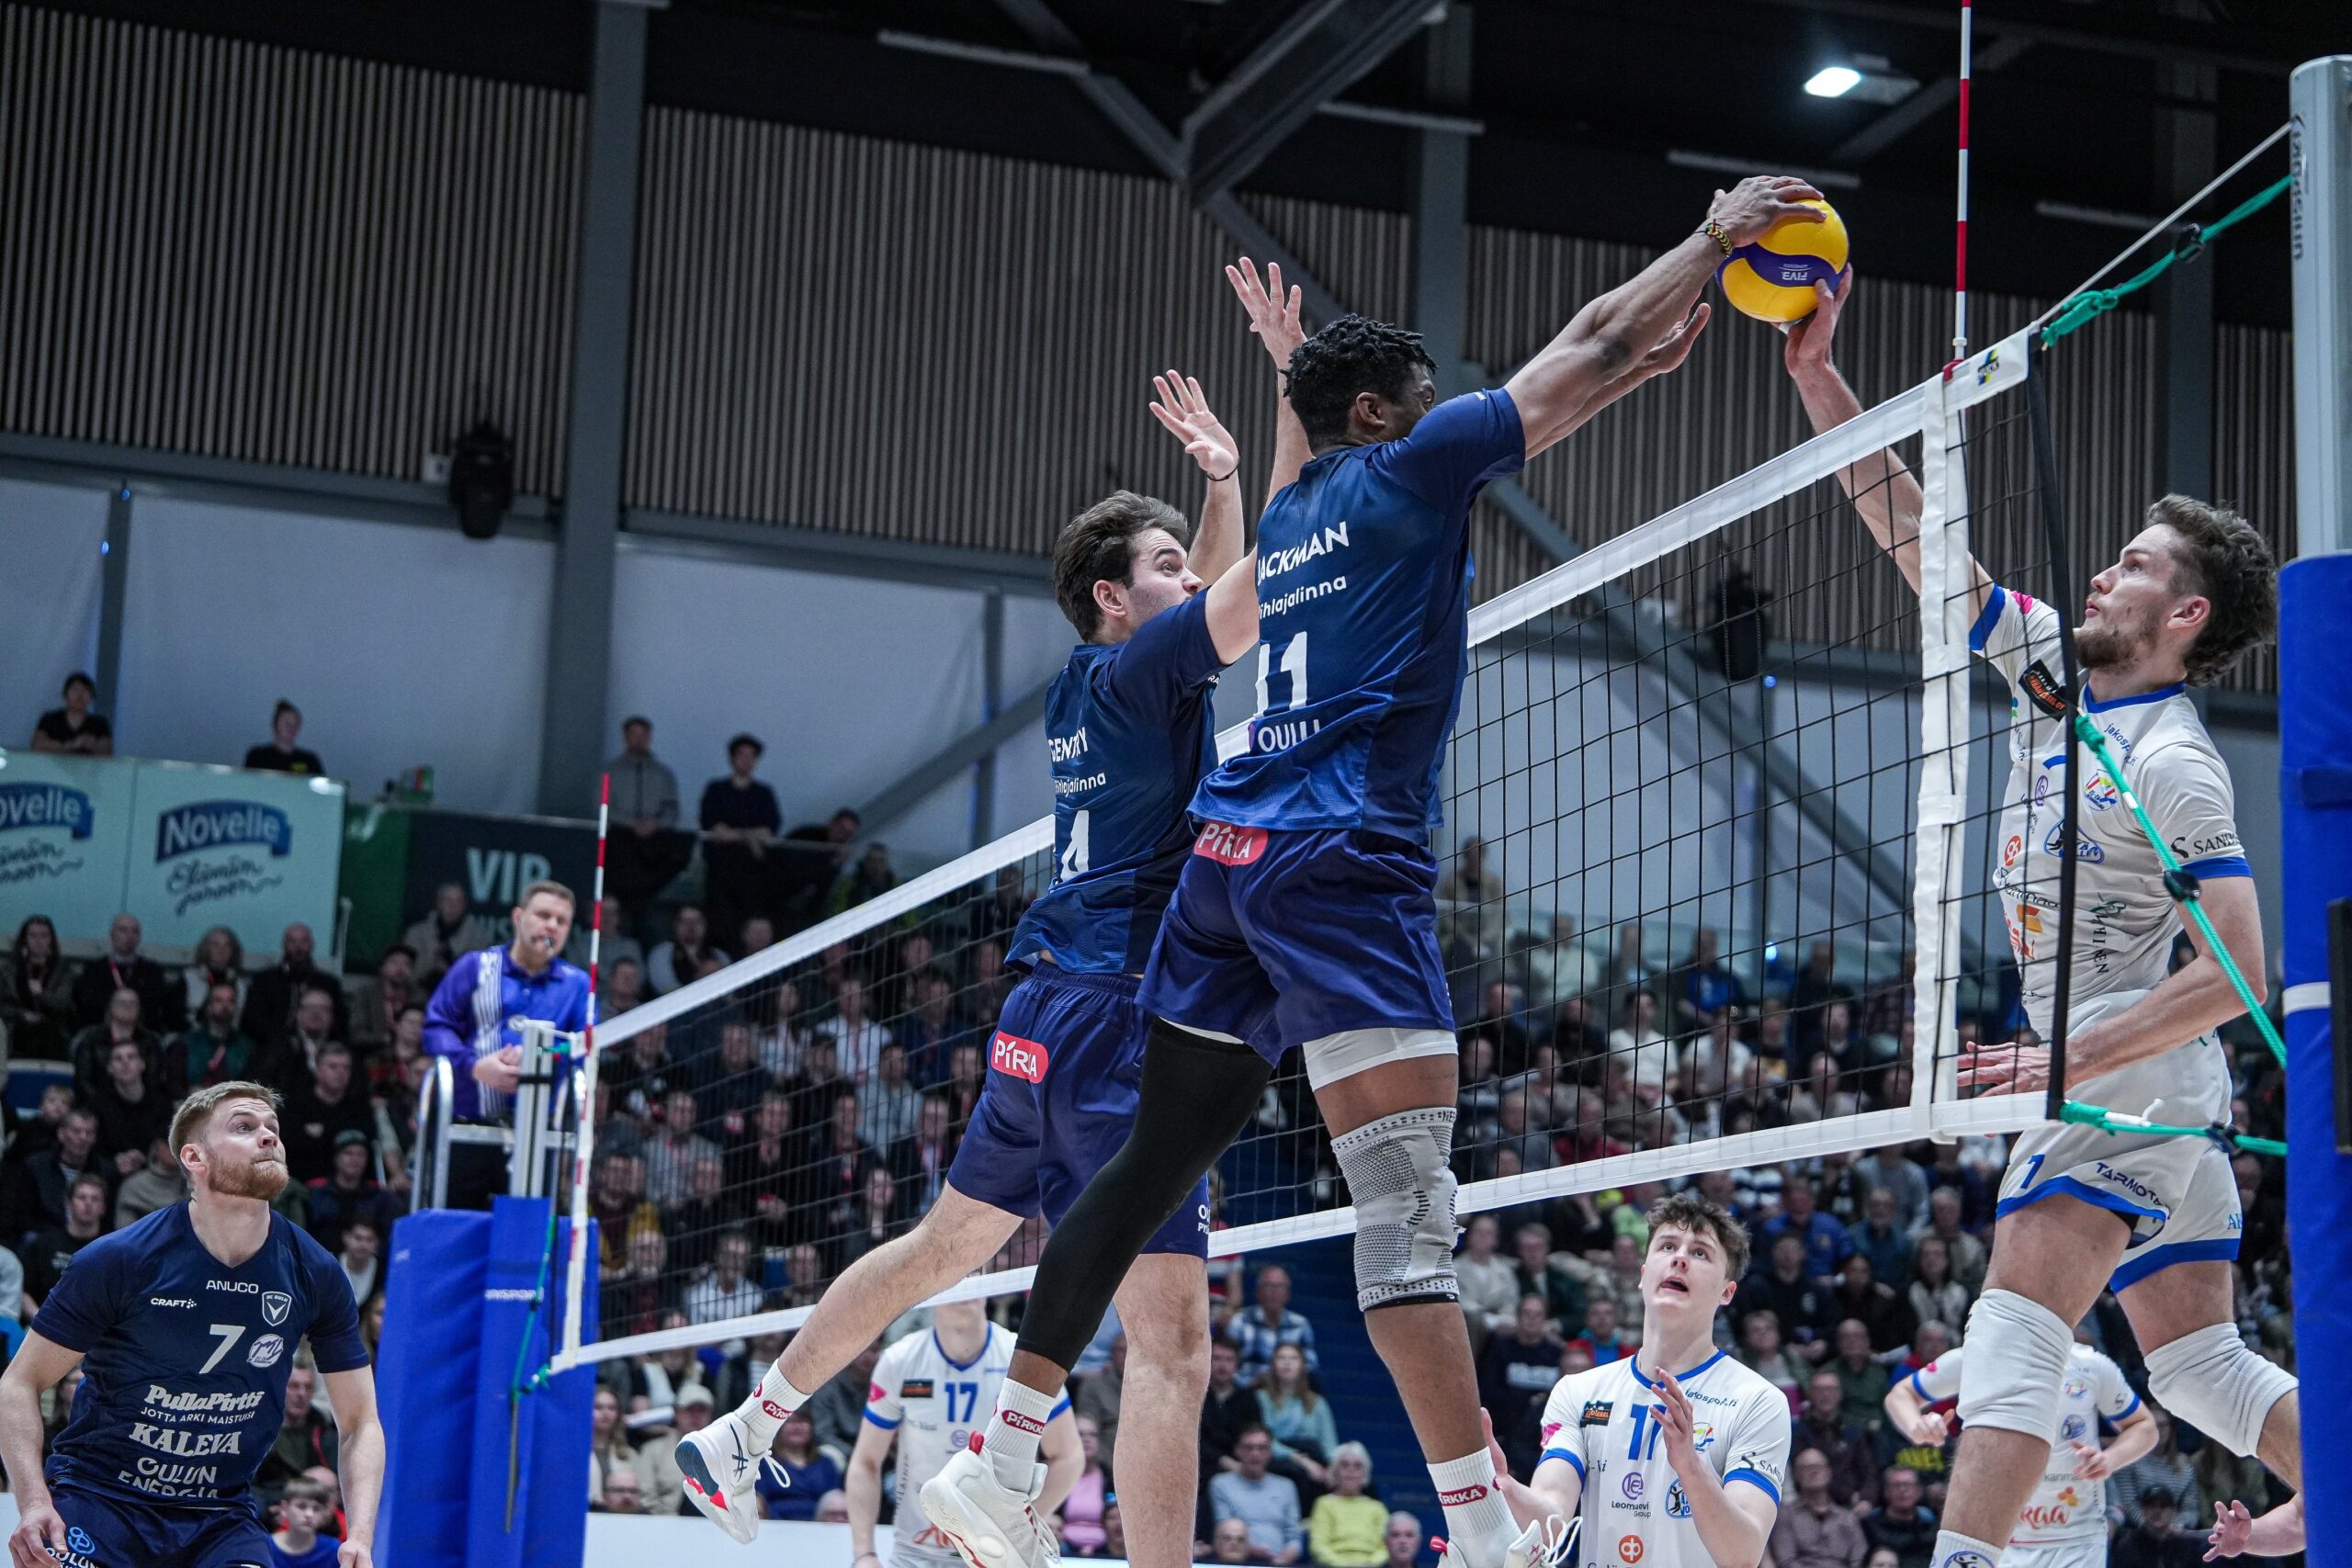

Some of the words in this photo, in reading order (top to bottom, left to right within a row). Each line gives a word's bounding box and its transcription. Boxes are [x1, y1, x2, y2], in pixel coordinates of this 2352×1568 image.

[1260, 576, 1347, 620] ihlajalinna
[1253, 631, 1307, 721] 11
[0, 785, 81, 825] ovelle
[164, 807, 281, 854] Novelle
[466, 847, 551, 904] VIP
[151, 1298, 187, 1308] CRAFT
[206, 1280, 259, 1294] ANUCO
[199, 1324, 246, 1374] 7
[141, 1406, 176, 1422] JOTTA
[179, 1413, 205, 1422] ARKI
[208, 1411, 255, 1425] MAISTUISI
[144, 1384, 265, 1412] PullaPirtti
[944, 1382, 978, 1422] 17
[129, 1422, 242, 1457] KALEVA
